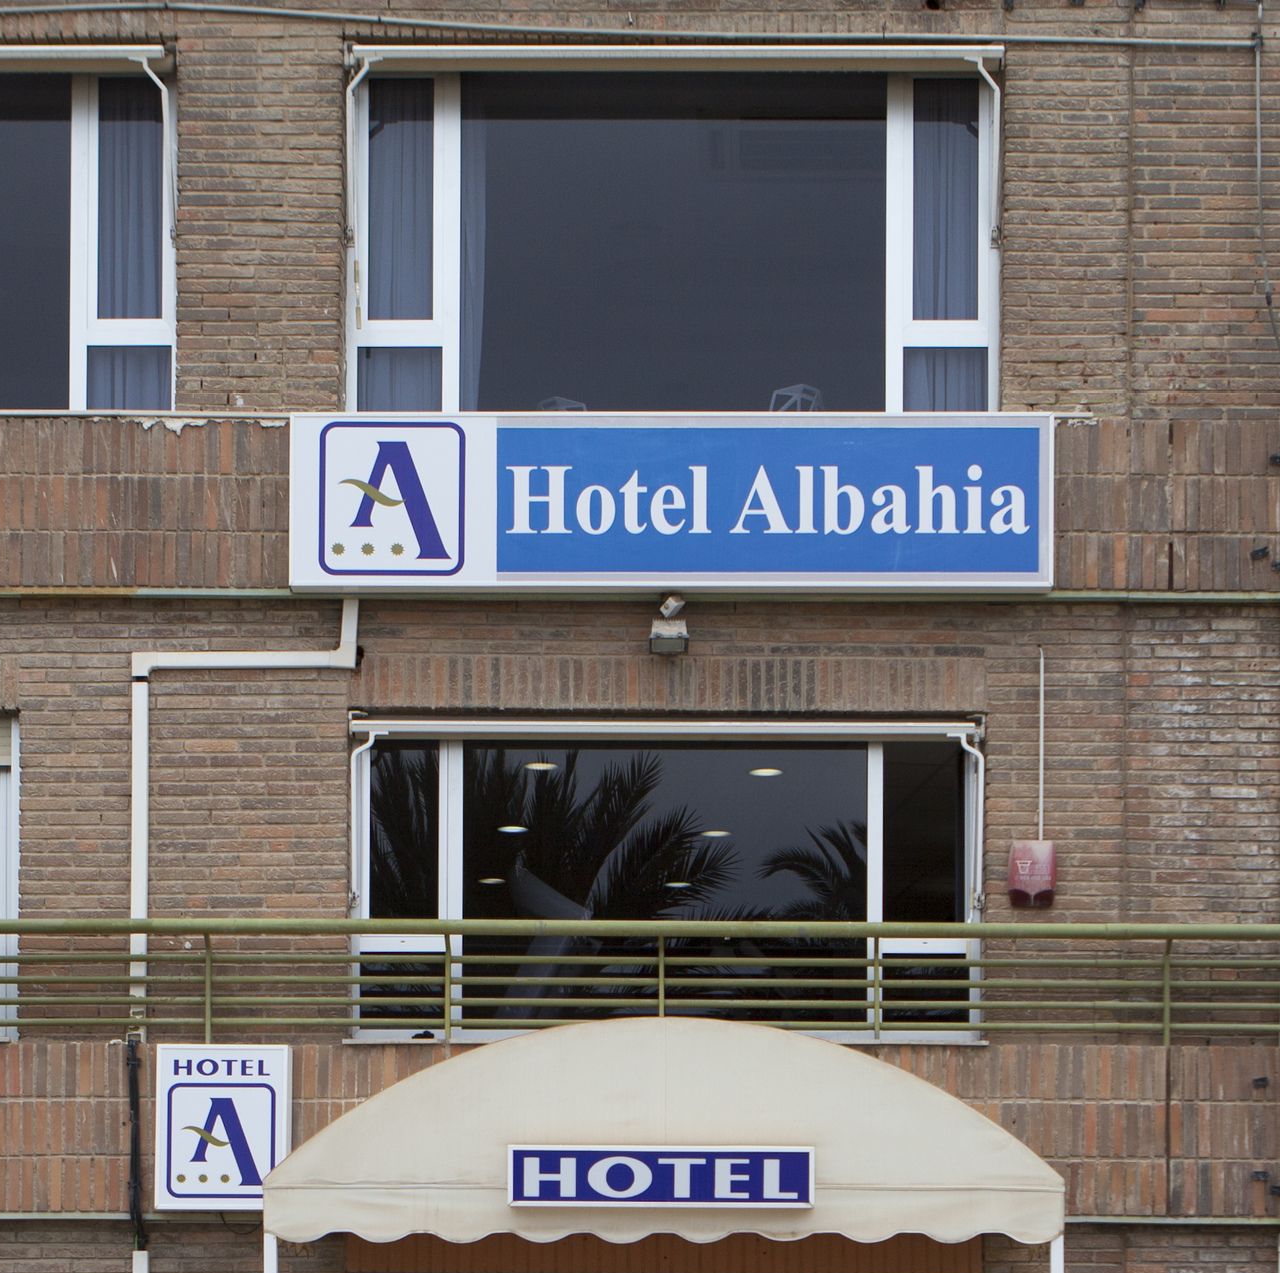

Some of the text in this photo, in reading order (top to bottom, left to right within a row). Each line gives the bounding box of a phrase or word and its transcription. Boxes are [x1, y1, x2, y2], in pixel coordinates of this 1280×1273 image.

[505, 464, 1031, 536] Hotel Albahia
[173, 1058, 271, 1076] HOTEL
[523, 1155, 799, 1200] HOTEL
